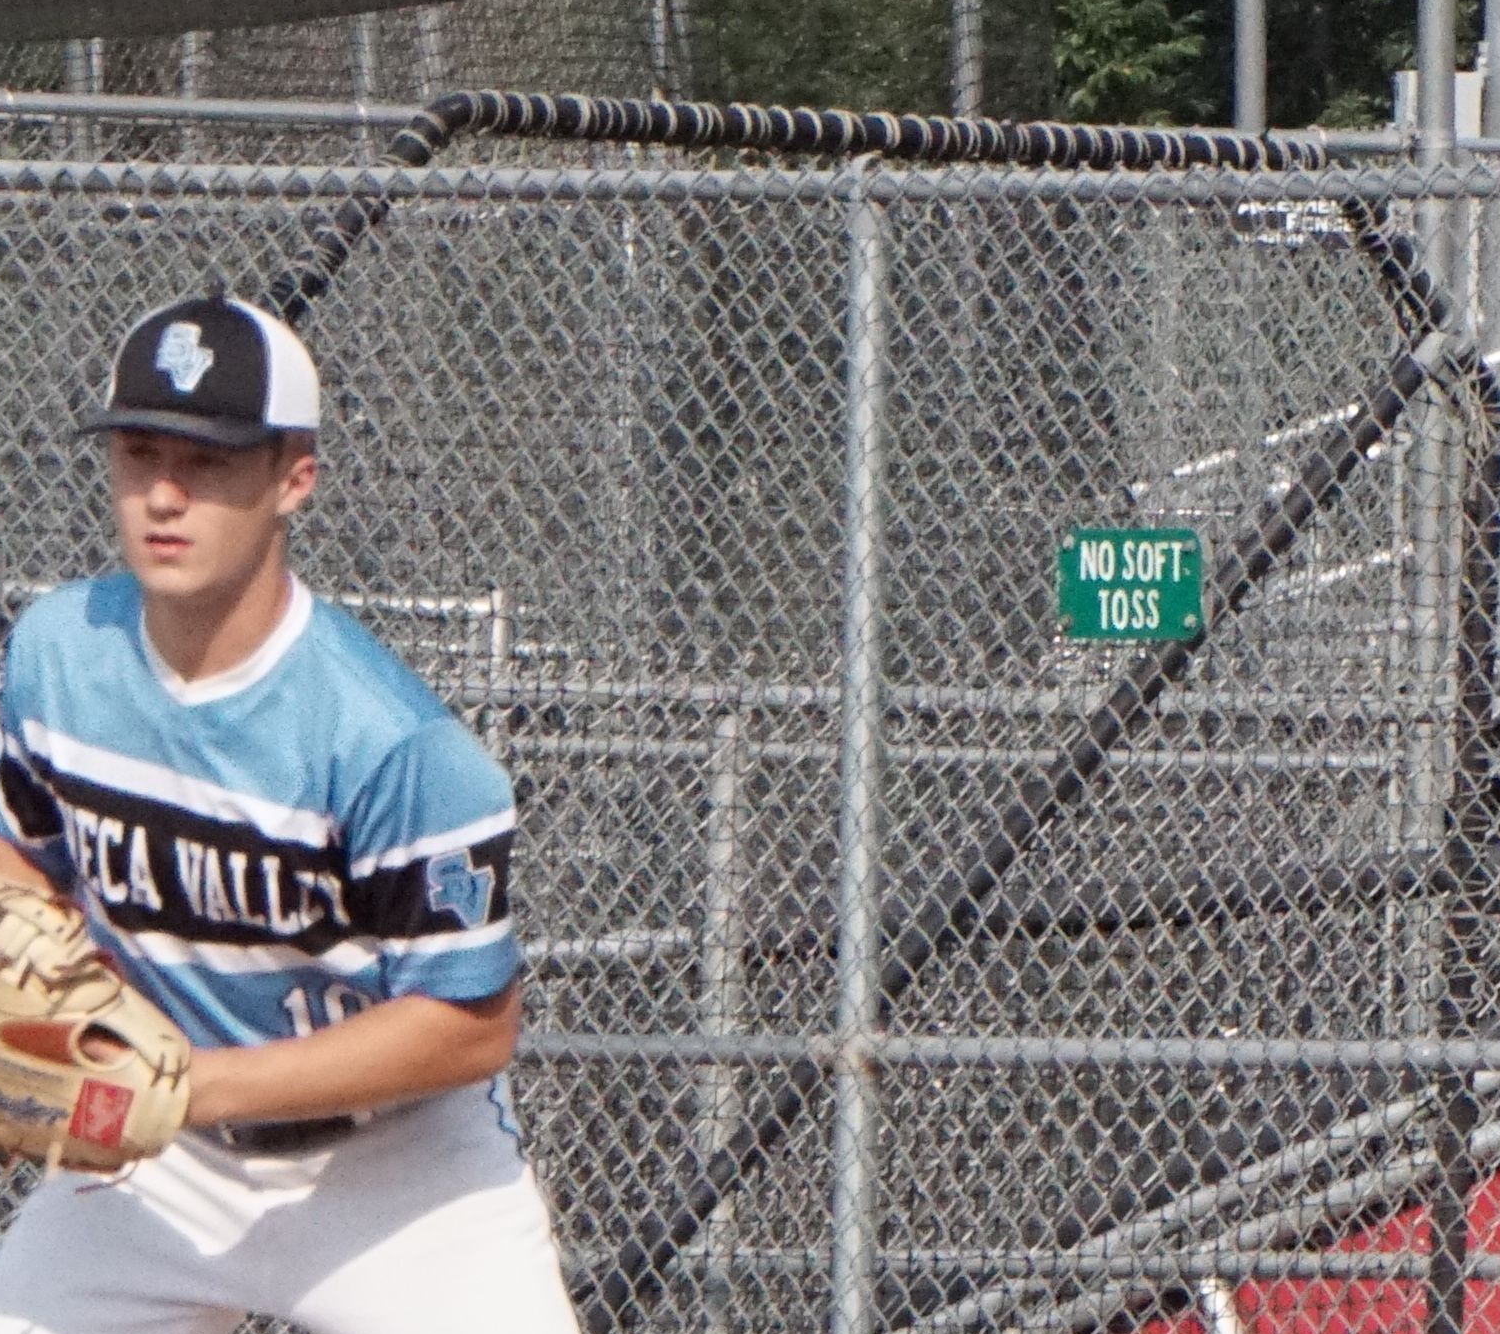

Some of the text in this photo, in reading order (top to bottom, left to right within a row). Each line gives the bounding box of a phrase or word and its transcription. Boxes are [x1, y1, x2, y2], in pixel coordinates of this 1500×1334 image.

[1080, 540, 1183, 582] NO SOFT
[1097, 589, 1160, 630] TOSS
[174, 835, 351, 936] VALLEY
